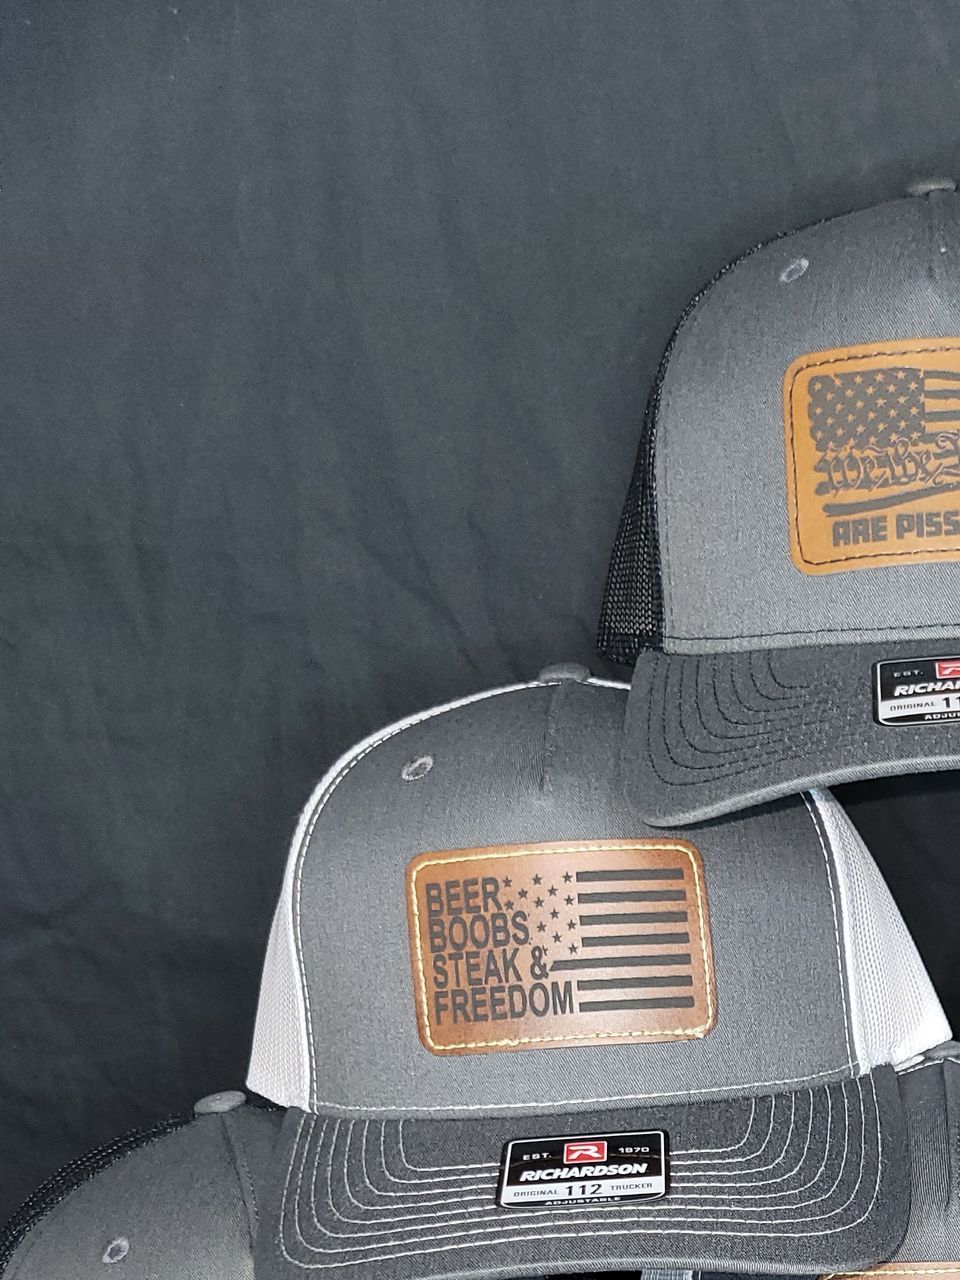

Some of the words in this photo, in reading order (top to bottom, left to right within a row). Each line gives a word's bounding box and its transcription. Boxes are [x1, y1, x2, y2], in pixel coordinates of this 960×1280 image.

[833, 515, 888, 547] ARE
[890, 701, 936, 711] ORIGINAL
[425, 877, 504, 918] BEER
[428, 910, 530, 953] BOOBS
[433, 949, 522, 989] STEAK
[530, 946, 550, 980] &
[434, 981, 574, 1025] FREEDOM
[523, 1152, 552, 1161] EST.
[513, 1189, 558, 1197] ORIGINAL
[566, 1184, 602, 1196] 112
[610, 1183, 653, 1191] TRUCKER
[545, 1197, 621, 1205] ADJUSTABLE
